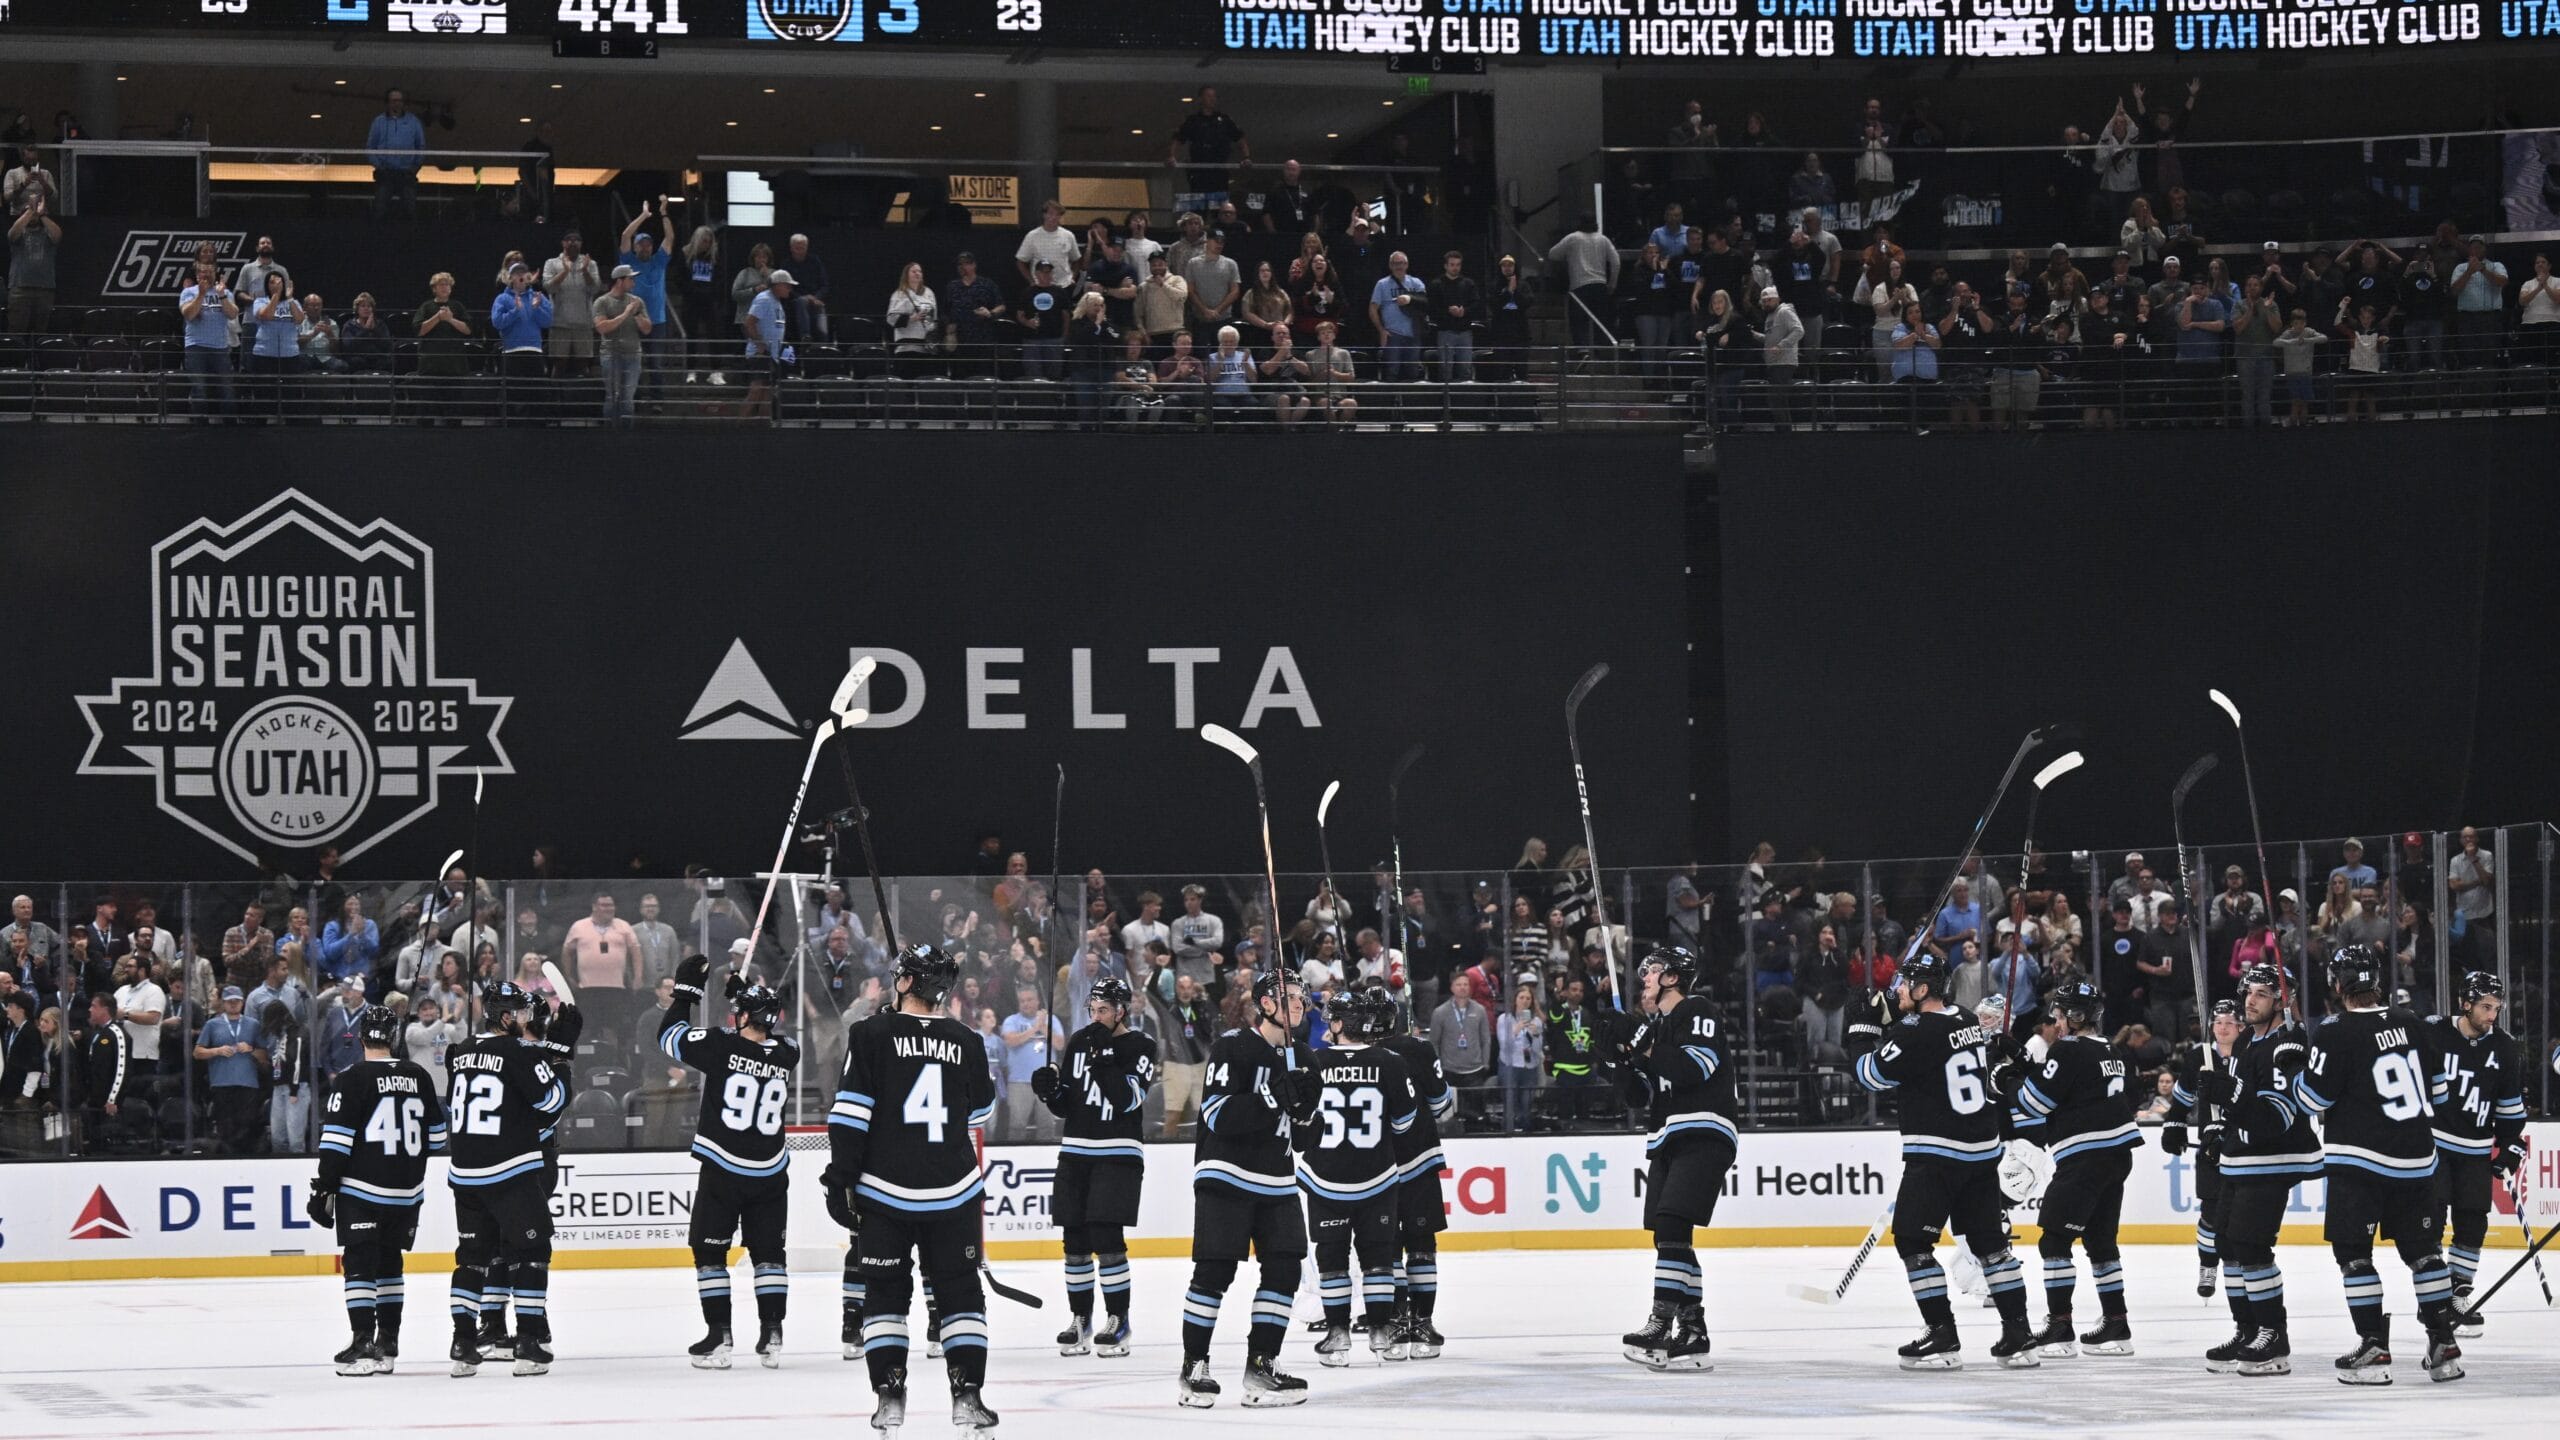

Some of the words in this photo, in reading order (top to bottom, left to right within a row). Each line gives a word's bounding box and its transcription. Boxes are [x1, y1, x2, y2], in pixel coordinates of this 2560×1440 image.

[557, 0, 688, 33] 4:41
[788, 24, 823, 37] CLUB
[997, 0, 1042, 31] 23
[2175, 14, 2257, 50] UTAH
[2267, 8, 2391, 49] HOCKEY
[2398, 3, 2480, 44] CLUB
[2501, 0, 2560, 37] UTA
[1224, 12, 1307, 49] UTAH
[1441, 17, 1520, 54] CLUB
[1539, 19, 1620, 54] UTAH
[1629, 19, 1749, 56] HOCKEY
[1755, 19, 1834, 57] CLUB
[1854, 20, 1935, 56] UTAH
[2073, 16, 2154, 53] CLUB
[1408, 77, 1431, 94] EXIT
[969, 178, 1011, 198] STORE
[118, 239, 159, 288] 5
[171, 576, 415, 618] INAUGURAL
[172, 624, 416, 687] SEASON
[849, 646, 1322, 730] DELTA
[132, 700, 218, 731] 2024
[255, 713, 340, 740] HOCKEY
[374, 700, 458, 732] 2025
[245, 749, 348, 798] UTAH
[1575, 763, 1590, 816] CCM
[270, 810, 326, 829] CLUB
[2019, 839, 2032, 890] CCM
[2358, 971, 2370, 982] 91
[935, 990, 944, 1002] 4
[1691, 1015, 1716, 1039] 10
[1948, 1025, 1984, 1050] CROUSE
[2374, 1027, 2409, 1051] DOAN
[893, 1036, 962, 1065] VALIMAKI
[2308, 1046, 2327, 1076] 91
[728, 1054, 790, 1083] SERGACHEV
[1205, 1062, 1230, 1087] 84
[1320, 1066, 1380, 1084] MACCELLI
[2042, 1059, 2059, 1080] 9
[2099, 1060, 2126, 1078] KELLER
[2273, 1067, 2287, 1091] 5
[377, 1075, 418, 1094] BARRON
[2372, 1049, 2435, 1121] 91
[2443, 1052, 2491, 1128] UTAH
[451, 1073, 504, 1136] 82
[721, 1072, 788, 1136] 98
[903, 1063, 949, 1144] 4
[1318, 1087, 1384, 1149] 63
[365, 1096, 425, 1156] 46
[1757, 1162, 1884, 1197] Health
[159, 1184, 311, 1232] DEL
[1319, 1217, 1350, 1228] CCM
[554, 1231, 577, 1241] RRY
[583, 1230, 641, 1240] LIMEADE
[647, 1229, 689, 1239] PRE-W
[861, 1256, 901, 1267] BAUER
[1836, 1233, 1878, 1300] WARRIOR
